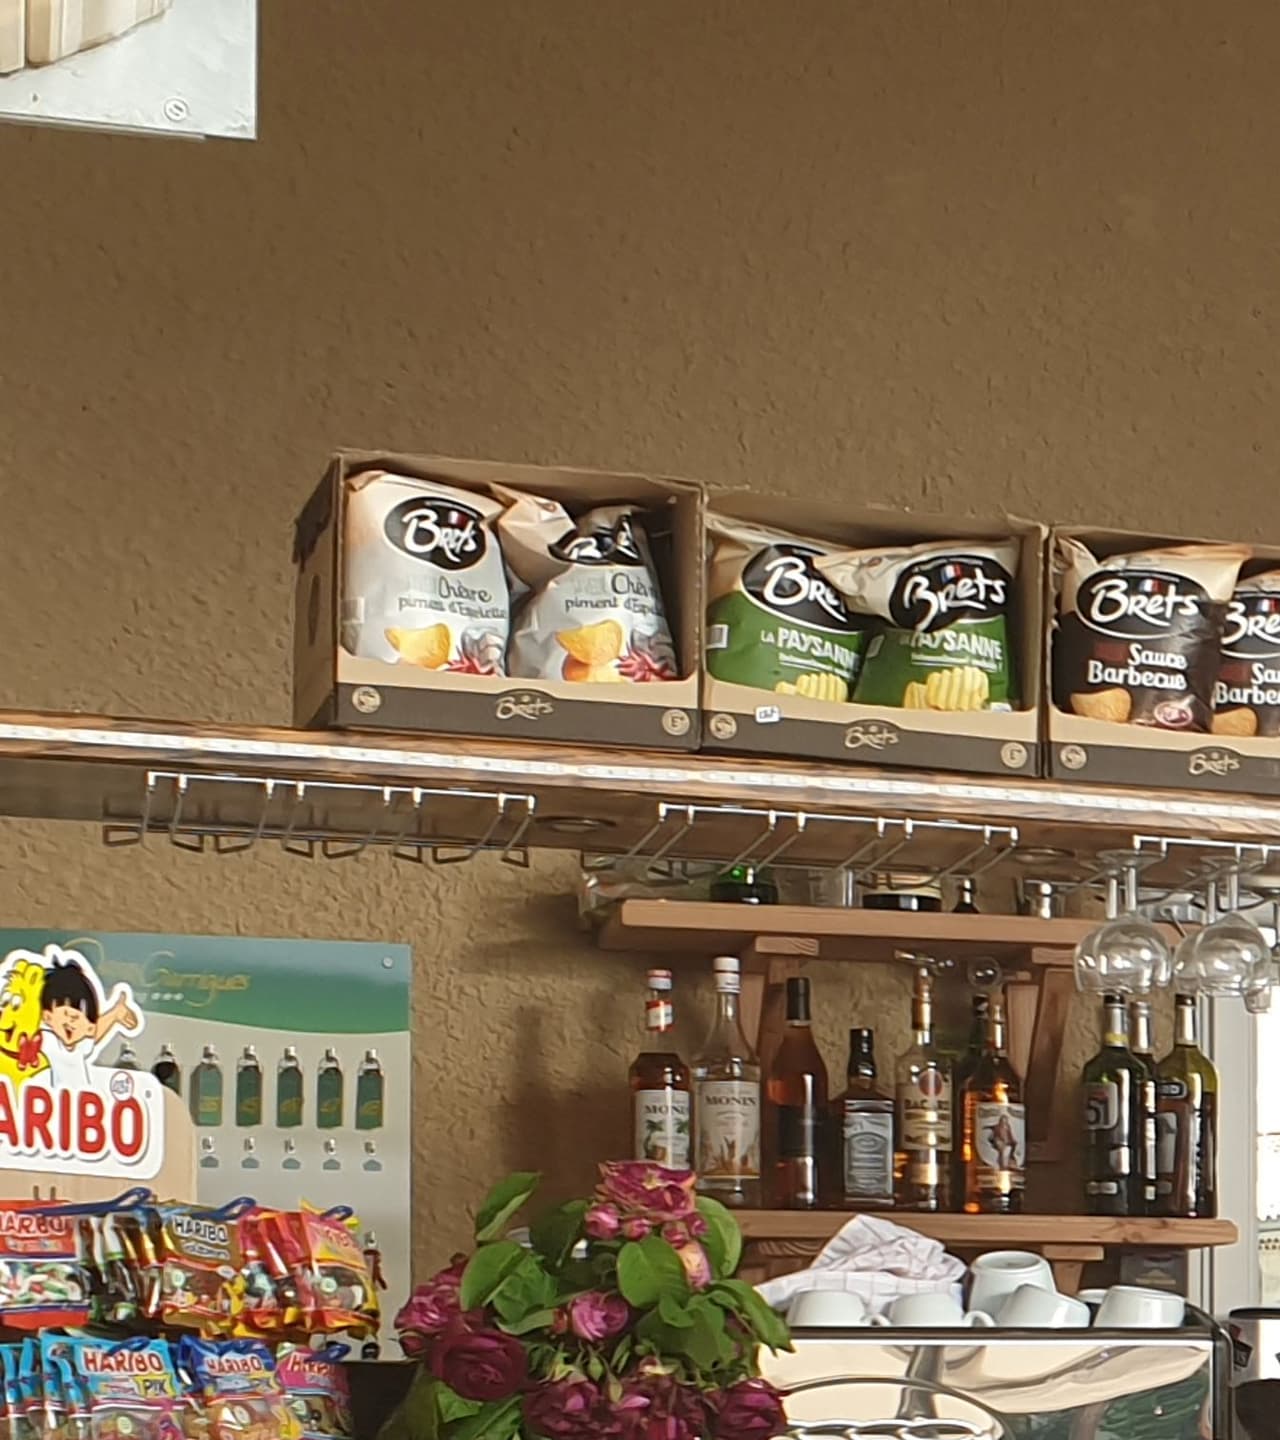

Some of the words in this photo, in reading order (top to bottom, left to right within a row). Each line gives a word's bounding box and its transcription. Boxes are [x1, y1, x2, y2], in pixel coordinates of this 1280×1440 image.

[564, 598, 619, 614] piment
[903, 568, 1007, 634] Brets
[1090, 579, 1201, 627] Brets
[1127, 642, 1188, 670] Sauce
[1088, 661, 1188, 691] Barbecue
[173, 1216, 229, 1243] HARIBO
[83, 1352, 164, 1374] HARIBO
[204, 1354, 263, 1372] HARIBO
